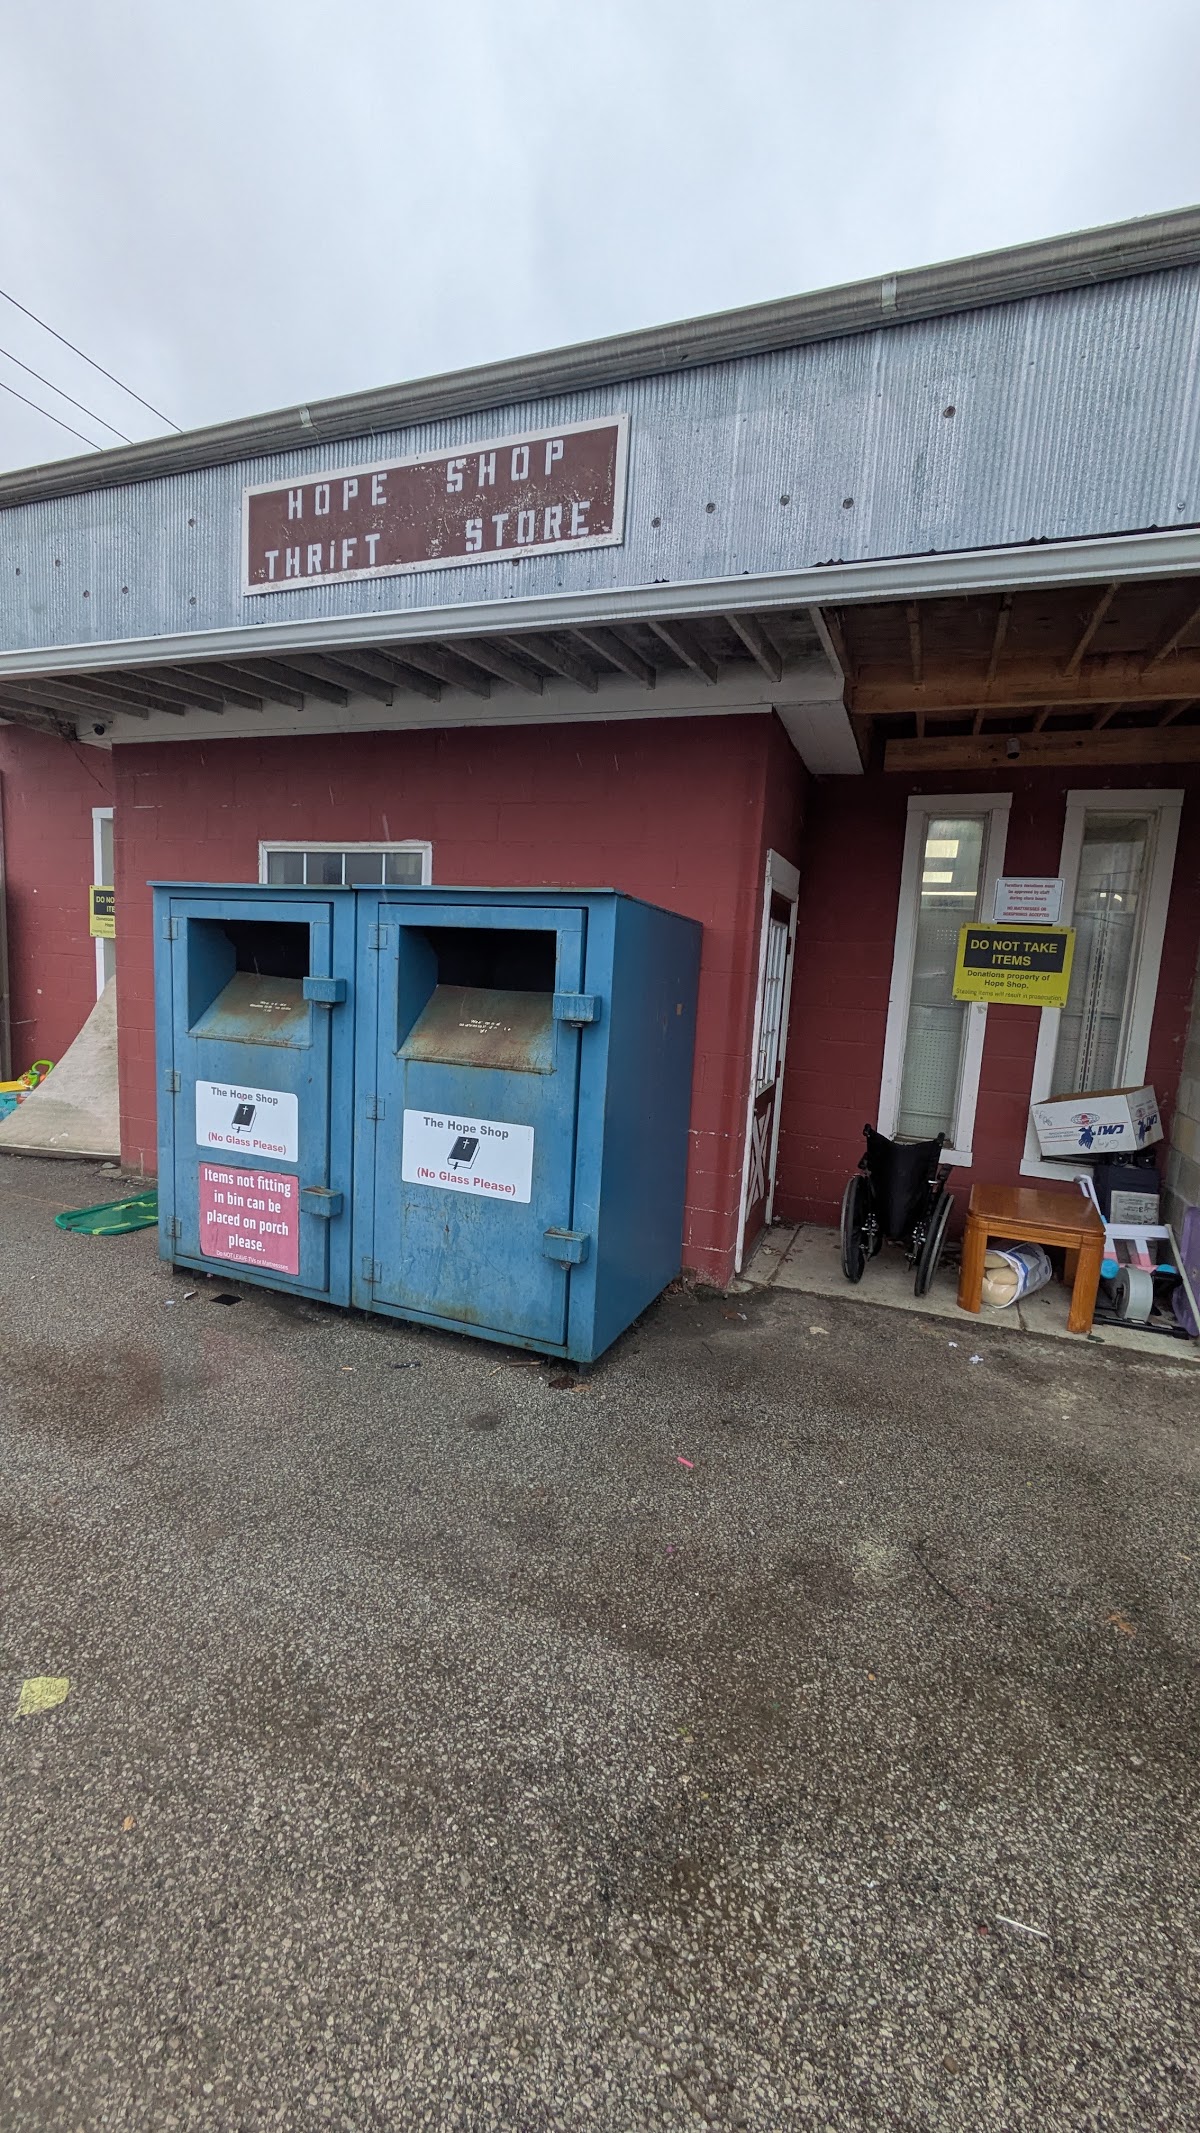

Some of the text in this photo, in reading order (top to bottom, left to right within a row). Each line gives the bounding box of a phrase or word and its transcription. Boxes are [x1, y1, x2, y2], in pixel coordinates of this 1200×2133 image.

[288, 439, 564, 520] HOPE SHOP
[465, 501, 590, 552] STORE
[970, 940, 1058, 954] DO NOT TAKE
[992, 954, 1031, 966] ITEMS
[967, 970, 1005, 978] Donations
[1007, 973, 1040, 982] property
[984, 980, 1029, 989] Hope Shop.
[955, 988, 977, 996] Stealing
[211, 1087, 278, 1106] The Hope Shop
[423, 1117, 509, 1140] The Hope Shop
[208, 1132, 286, 1155] (No Glass Please)
[204, 1168, 291, 1198] Items not fitting
[417, 1167, 516, 1195] (No Glass Please)
[214, 1190, 281, 1213] in bin can be
[207, 1210, 288, 1236] placed on porch
[228, 1234, 266, 1252] please.
